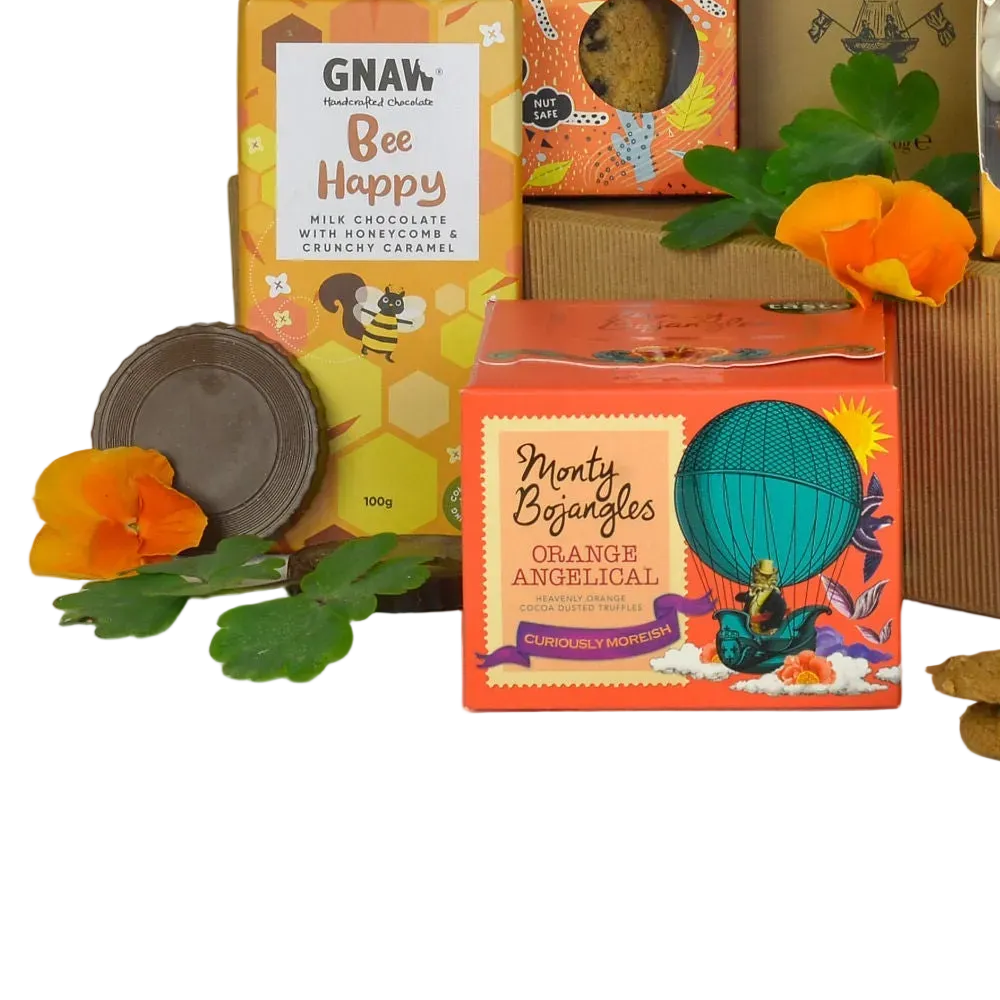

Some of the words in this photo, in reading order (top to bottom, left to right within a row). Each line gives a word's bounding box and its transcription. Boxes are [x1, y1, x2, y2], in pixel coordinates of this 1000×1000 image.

[323, 57, 434, 92] GNAW
[323, 95, 384, 109] Handcrafted
[387, 96, 433, 107] Chocolate
[534, 98, 556, 109] NUT
[534, 110, 558, 120] SAFE
[347, 113, 413, 162] Bee
[318, 159, 446, 208] Happy
[310, 215, 345, 225] MILK
[354, 215, 447, 225] CHOCOLATE
[299, 229, 337, 239] WITH
[345, 229, 441, 239] HONEYCOMB
[450, 229, 458, 239] &
[302, 243, 375, 253] CRUNCHY
[384, 243, 455, 253] CARAMEL
[517, 443, 619, 502] Monty
[364, 496, 393, 509] 100g
[513, 483, 655, 538] Bojangles
[532, 545, 637, 563] ORANGE
[511, 568, 659, 587] ANGELICAL
[519, 604, 554, 612] COCOA
[558, 604, 595, 612] DUSTED
[599, 603, 642, 612] TRUFFLES
[524, 633, 605, 650] CURIOUSLY
[606, 624, 672, 649] MOREISH
